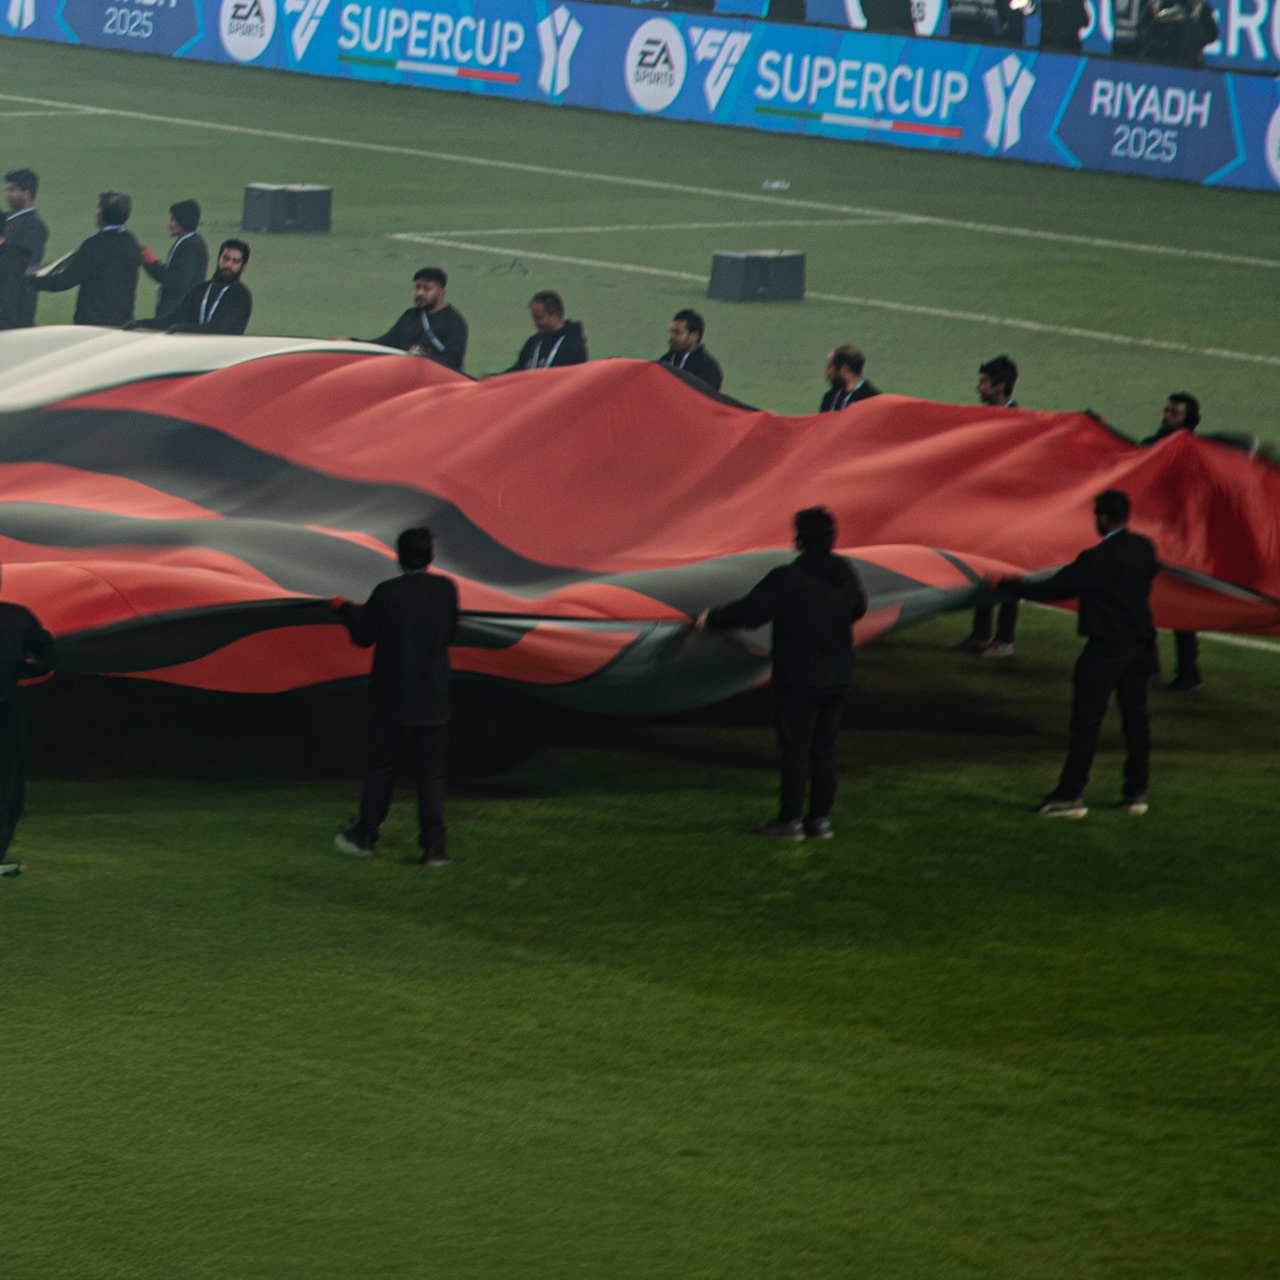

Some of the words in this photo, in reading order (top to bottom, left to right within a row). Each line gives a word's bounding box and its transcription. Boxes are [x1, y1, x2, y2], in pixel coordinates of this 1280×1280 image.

[103, 8, 154, 38] 2025
[338, 2, 525, 68] SUPERCUP
[637, 37, 675, 70] EA
[754, 49, 969, 119] SUPERCUP
[1090, 78, 1213, 129] RIYADH
[1111, 125, 1179, 164] 2025
